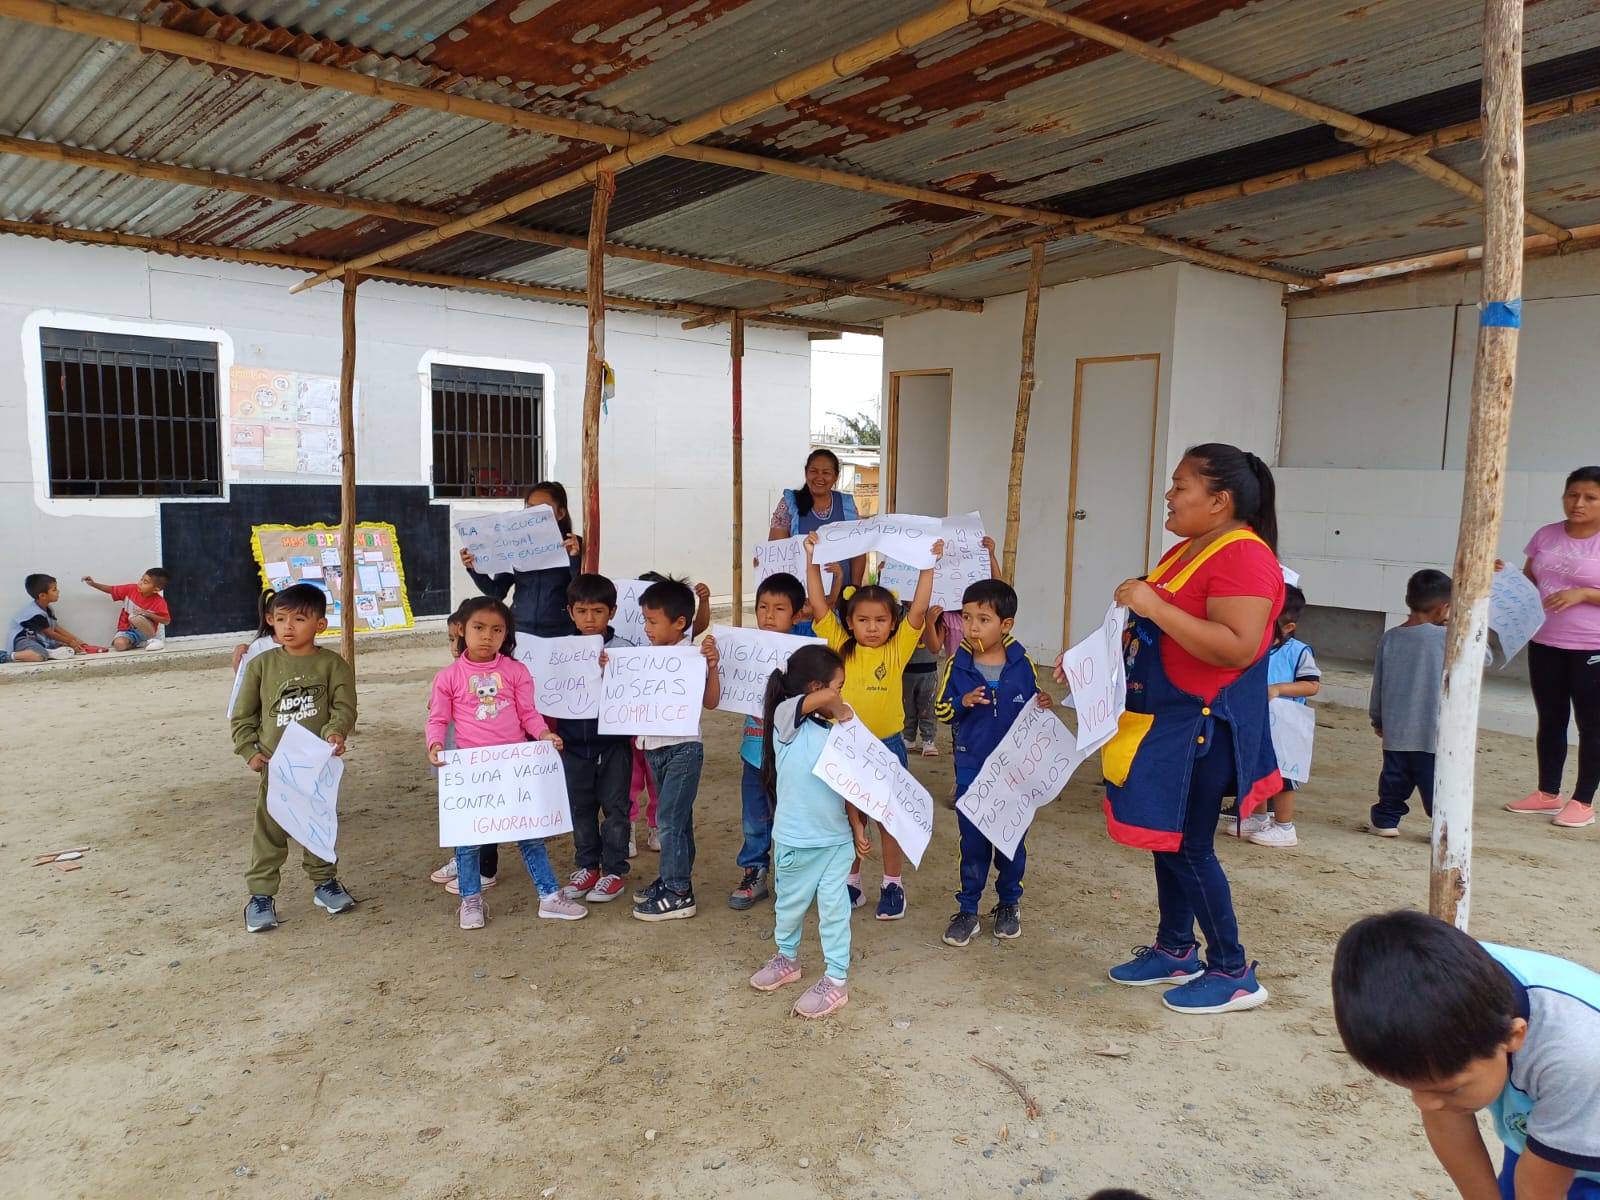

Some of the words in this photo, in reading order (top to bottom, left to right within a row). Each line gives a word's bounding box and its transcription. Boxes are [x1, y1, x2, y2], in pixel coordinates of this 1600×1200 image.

[494, 516, 548, 532] ESCUELA
[825, 525, 923, 541] CAMBIO
[282, 536, 304, 547] MES
[756, 541, 800, 563] PIENSA
[956, 528, 973, 560] ERES
[496, 552, 516, 561] SE
[548, 650, 597, 666] ESCUELA
[608, 654, 682, 679] VECINO
[718, 665, 726, 678] A
[1068, 656, 1094, 690] NO
[544, 676, 586, 692] CUIDA
[604, 684, 625, 700] NO
[630, 678, 687, 698] SEAS
[280, 696, 314, 712] ABOVE
[300, 702, 315, 712] AND
[1081, 688, 1115, 733] VIOL
[276, 708, 318, 728] BEYOND
[470, 742, 550, 765] EDUCACIÓN
[833, 736, 856, 760] ES
[862, 754, 886, 780] TU
[444, 772, 464, 786] ES
[513, 762, 560, 778] VACUNA
[866, 742, 926, 809] ESCUELA
[444, 794, 506, 811] CONTRA
[978, 798, 1006, 832] TUS
